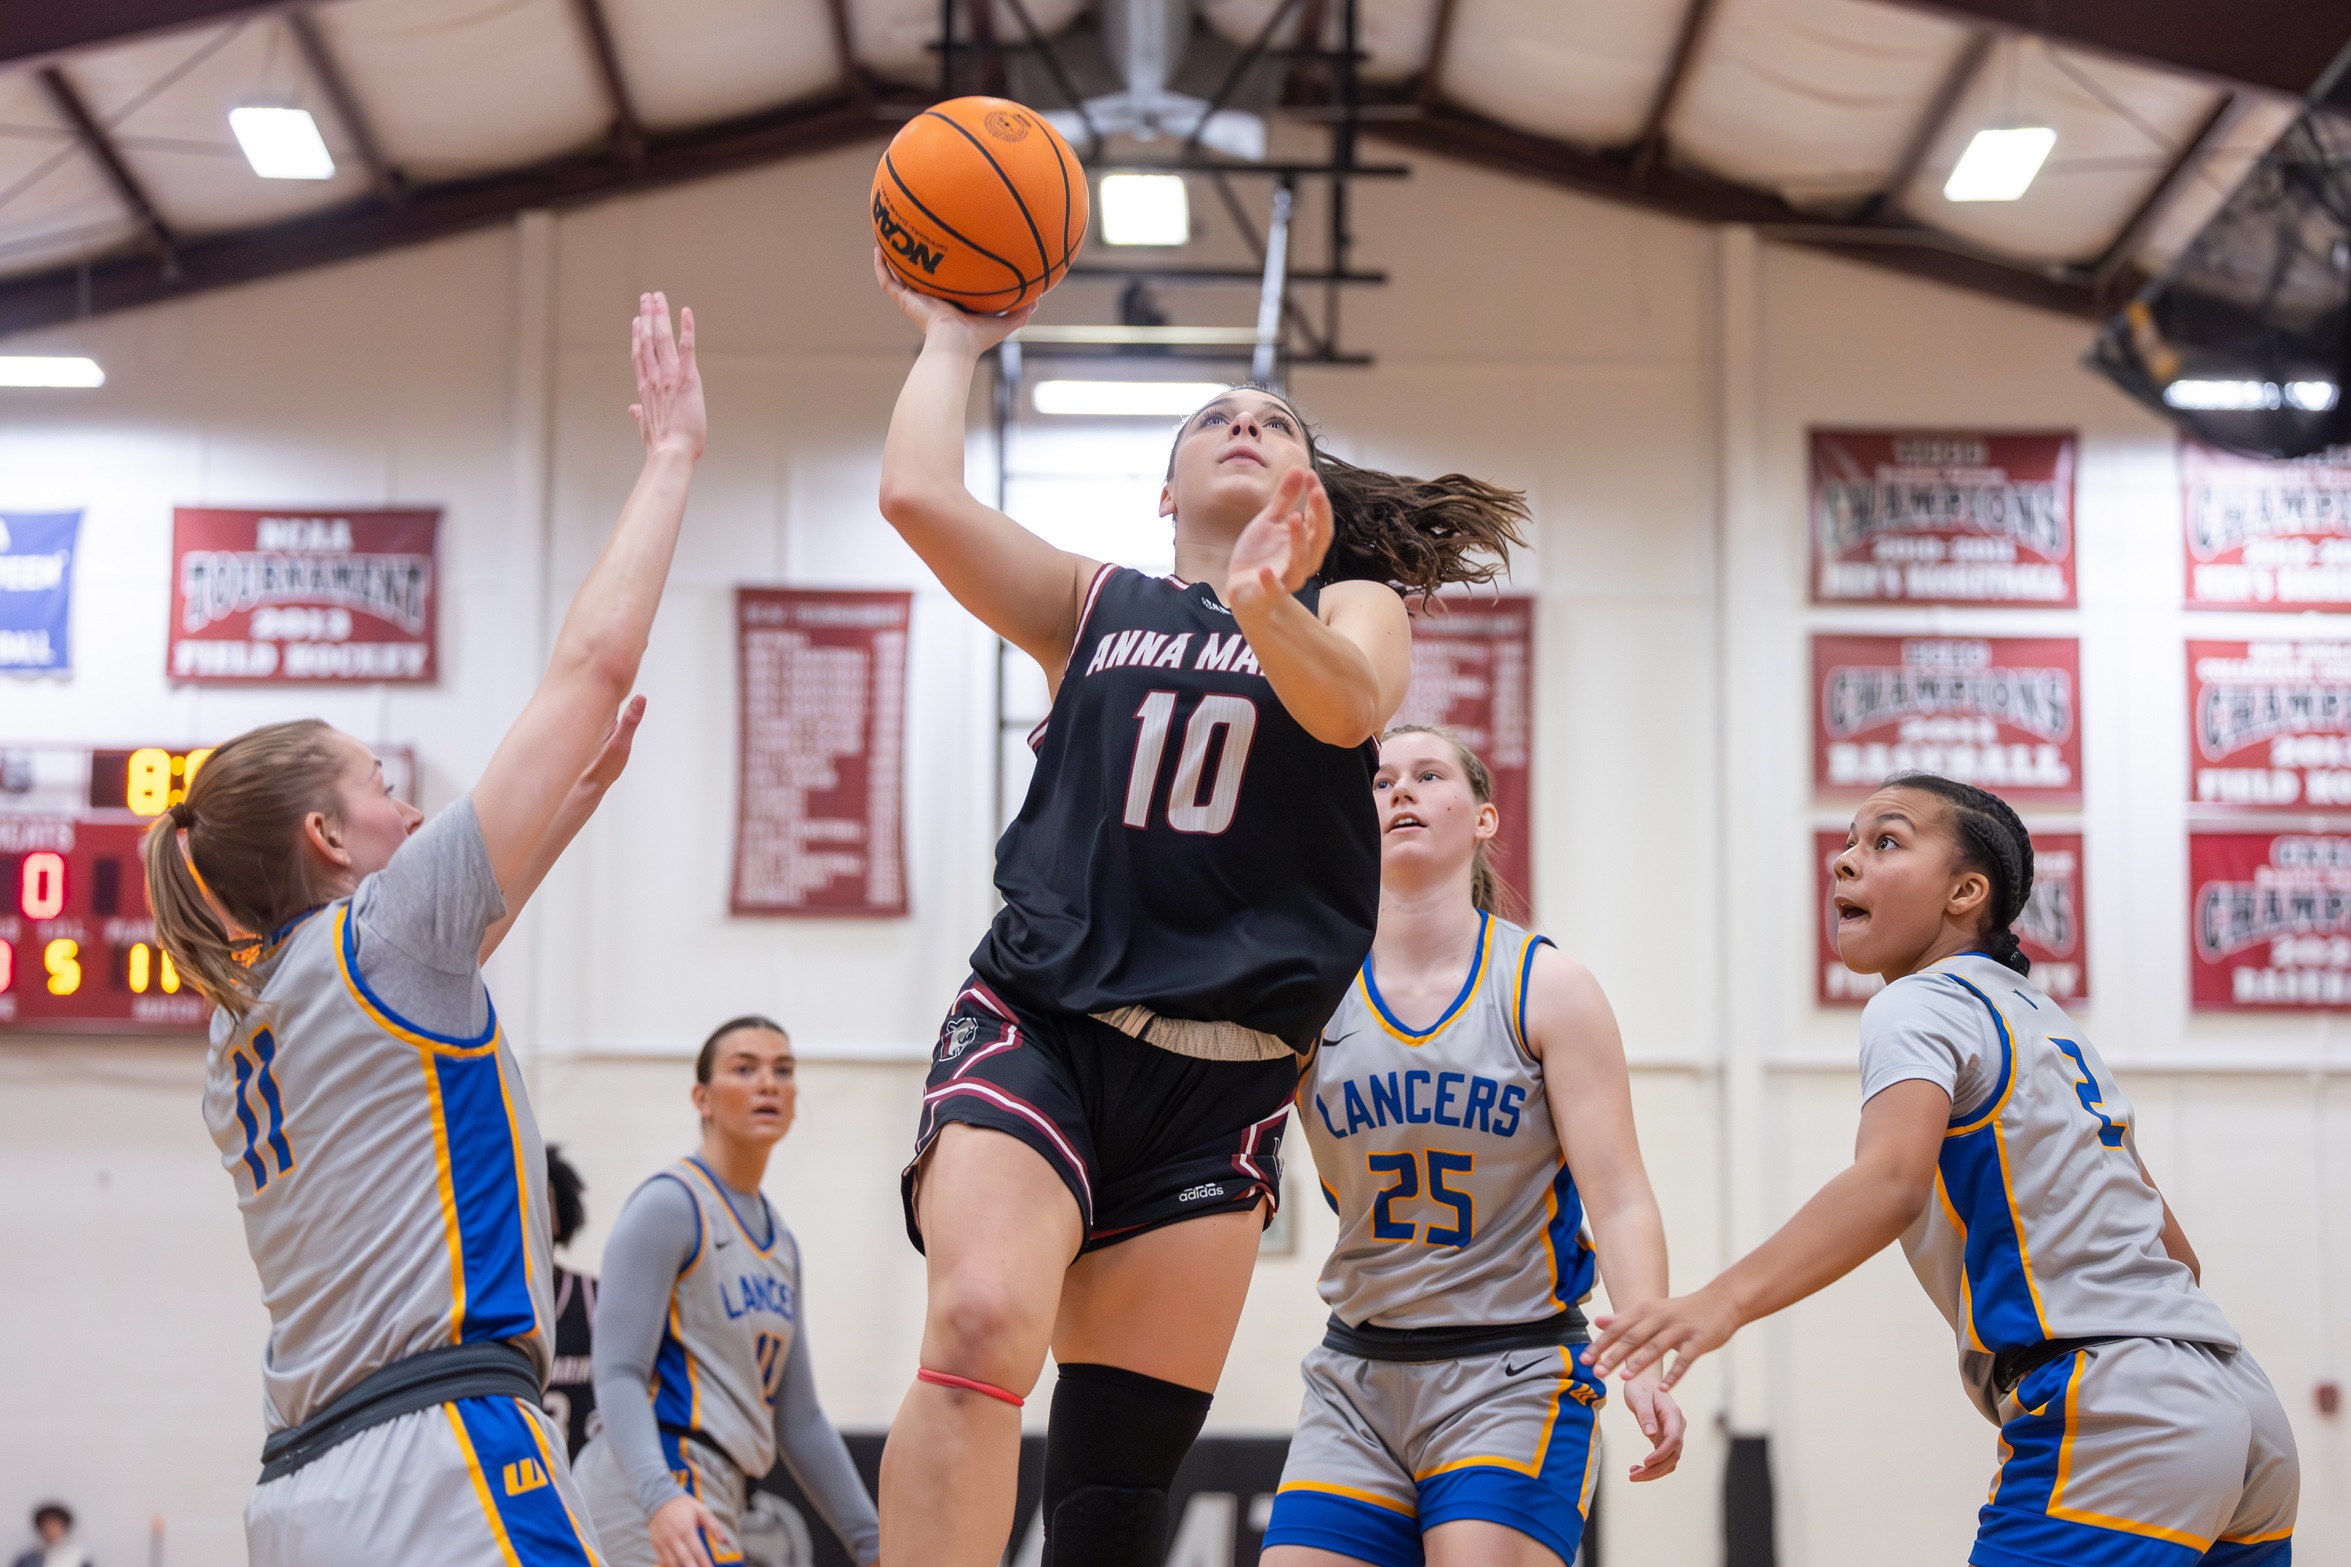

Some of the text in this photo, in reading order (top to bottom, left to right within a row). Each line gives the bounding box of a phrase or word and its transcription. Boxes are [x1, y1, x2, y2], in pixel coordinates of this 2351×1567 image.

[873, 188, 945, 275] NCAA
[257, 518, 353, 550] NCAA
[182, 551, 430, 635] TOURNAMENT
[174, 641, 428, 678] FIELD HOCKEY
[1086, 629, 1266, 677] ANNA MA
[1823, 668, 2072, 742] CHAMPIONS
[1122, 689, 1259, 837] 10
[22, 852, 65, 919] 0
[45, 938, 81, 995] 5
[229, 1023, 297, 1197] 11
[1316, 1070, 1527, 1139] LANCERS
[2044, 1035, 2128, 1151] 2
[1178, 1183, 1225, 1203] adidas
[1365, 1147, 1476, 1251] 25
[718, 1273, 795, 1322] LANCE
